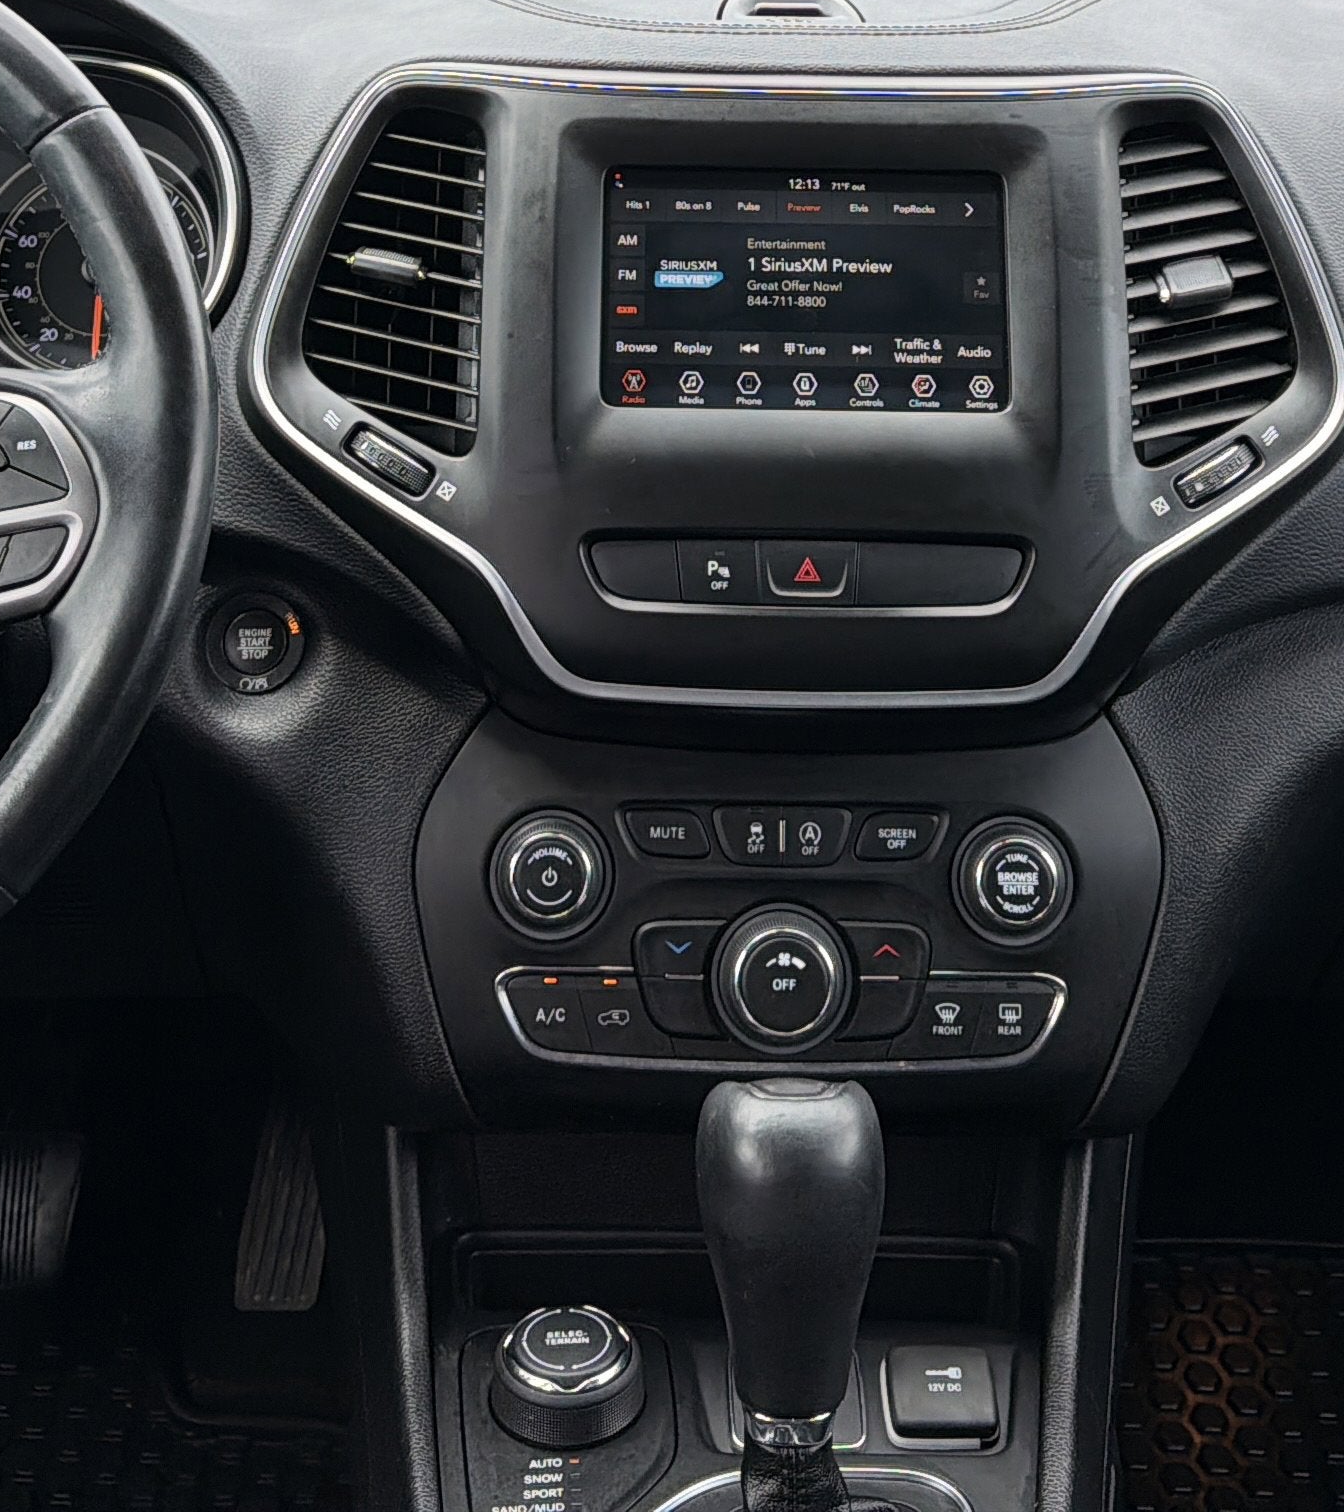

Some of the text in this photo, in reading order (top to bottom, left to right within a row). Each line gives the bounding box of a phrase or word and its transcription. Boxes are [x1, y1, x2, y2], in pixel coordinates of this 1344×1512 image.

[788, 178, 821, 191] 12:13
[625, 200, 644, 210] Hits
[675, 200, 691, 211] 80s
[692, 202, 705, 211] on
[737, 201, 761, 212] Pulse
[893, 204, 937, 216] PopRocks
[17, 234, 38, 248] 60
[617, 234, 639, 246] AM
[746, 238, 827, 251] Entertainment
[659, 259, 719, 271] SIRIUSXM
[747, 257, 893, 274] 1 SiriusXM Preview
[617, 269, 638, 281] FM
[12, 285, 32, 299] 40
[746, 279, 844, 293] Great Offer Now!
[746, 295, 827, 308] 844-711-8800
[39, 327, 59, 342] 20
[616, 340, 659, 353] Browse
[673, 341, 713, 356] Replay
[797, 343, 827, 356] Tune
[893, 338, 943, 351] Traffic &
[893, 351, 944, 365] Weather
[957, 346, 993, 359] Audio
[678, 395, 705, 405] Media
[736, 396, 763, 406] Phone
[794, 397, 817, 408] Apps
[849, 398, 885, 408] Controls
[908, 399, 941, 409] Climate
[965, 399, 999, 410] Settings
[16, 440, 37, 451] RES
[710, 580, 729, 592] OFF
[238, 627, 273, 638] ENGINE
[239, 637, 271, 648] START
[241, 649, 269, 660] STOP
[649, 826, 686, 840] MUTE
[878, 828, 917, 839] SCREEN
[747, 844, 765, 854] OFF
[886, 839, 907, 850] OFF
[533, 846, 568, 861] VOLUME
[801, 846, 820, 856] OFF
[1006, 853, 1029, 864] TUNE
[997, 871, 1040, 883] BROWSE
[1002, 885, 1035, 896] ENTER
[1002, 902, 1034, 913] SCROLL
[772, 978, 797, 992] OFF
[535, 1007, 567, 1025] A/C
[932, 1025, 963, 1036] FRONT
[997, 1025, 1022, 1036] REAR
[544, 1337, 590, 1347] TERRAIN
[927, 1382, 946, 1392] 12V
[528, 1457, 563, 1469] AUTO
[522, 1472, 563, 1485] SNOW
[521, 1487, 565, 1500] SPORT
[490, 1502, 565, 1512] SAND/MUD
